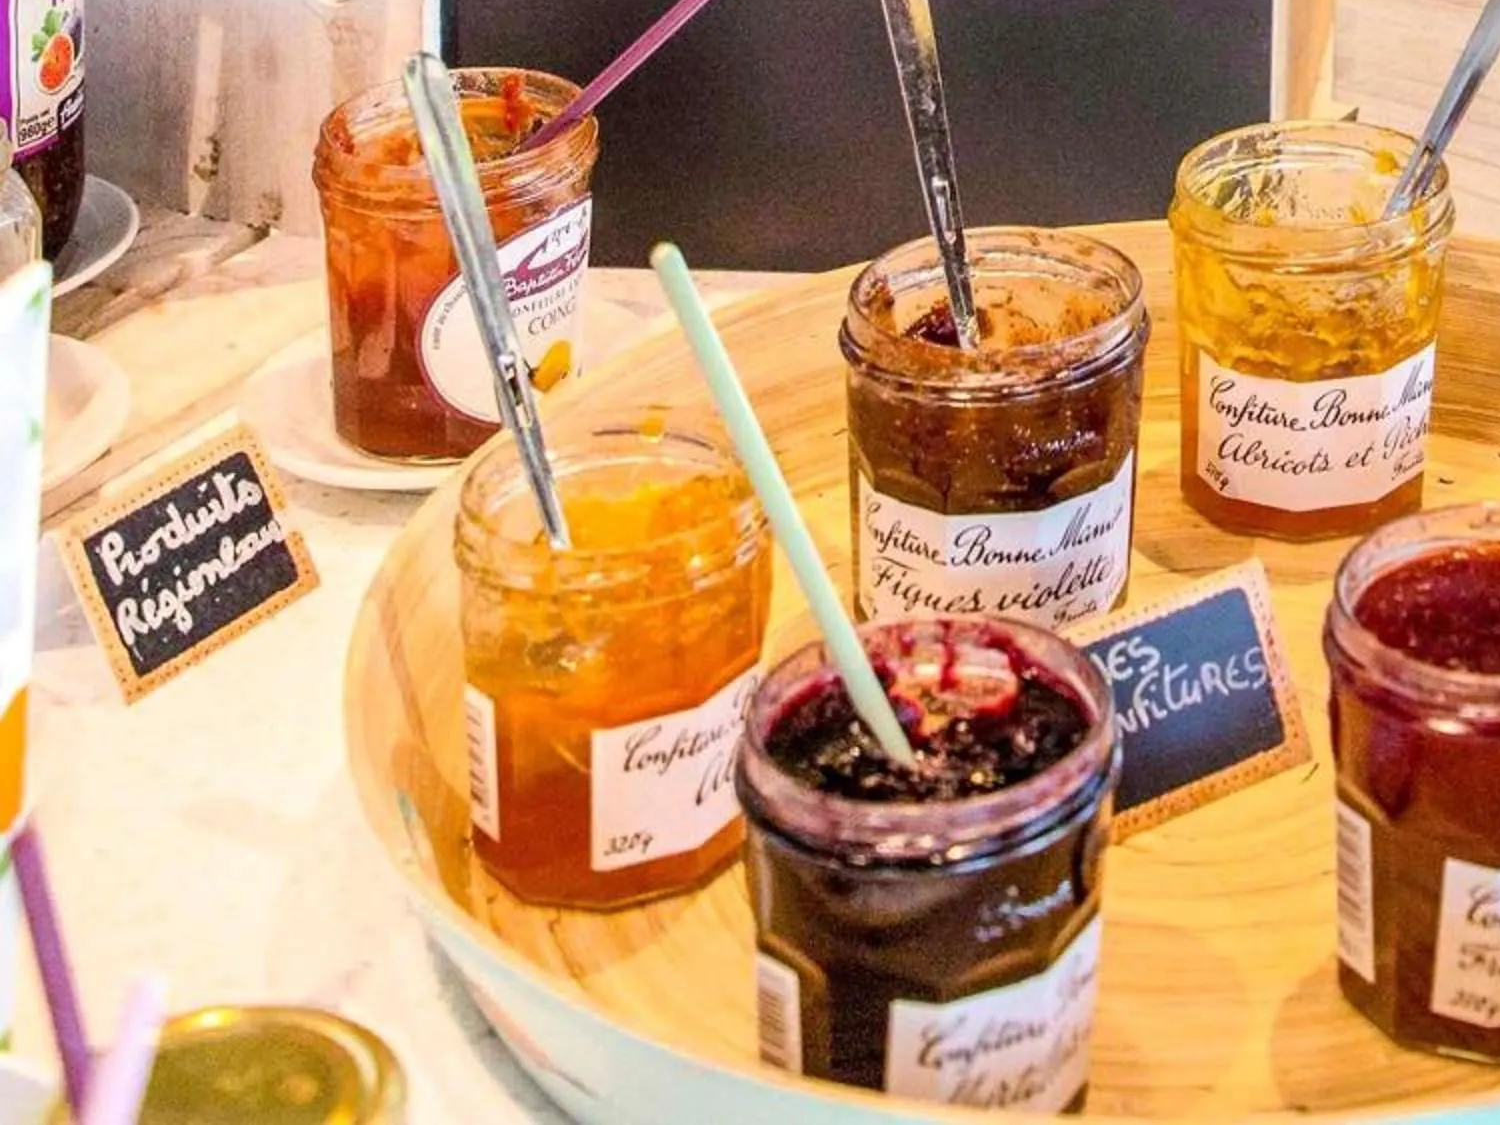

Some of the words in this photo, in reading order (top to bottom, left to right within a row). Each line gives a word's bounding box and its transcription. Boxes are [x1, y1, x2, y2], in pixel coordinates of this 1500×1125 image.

[1210, 374, 1306, 432] Confiture
[1309, 388, 1390, 430] Bonne
[1217, 432, 1329, 476] Abricots
[1345, 444, 1375, 469] et
[96, 471, 263, 586] Produits
[951, 523, 1046, 567] Bonne
[872, 555, 986, 614] Figues
[623, 724, 730, 775] Confiture
